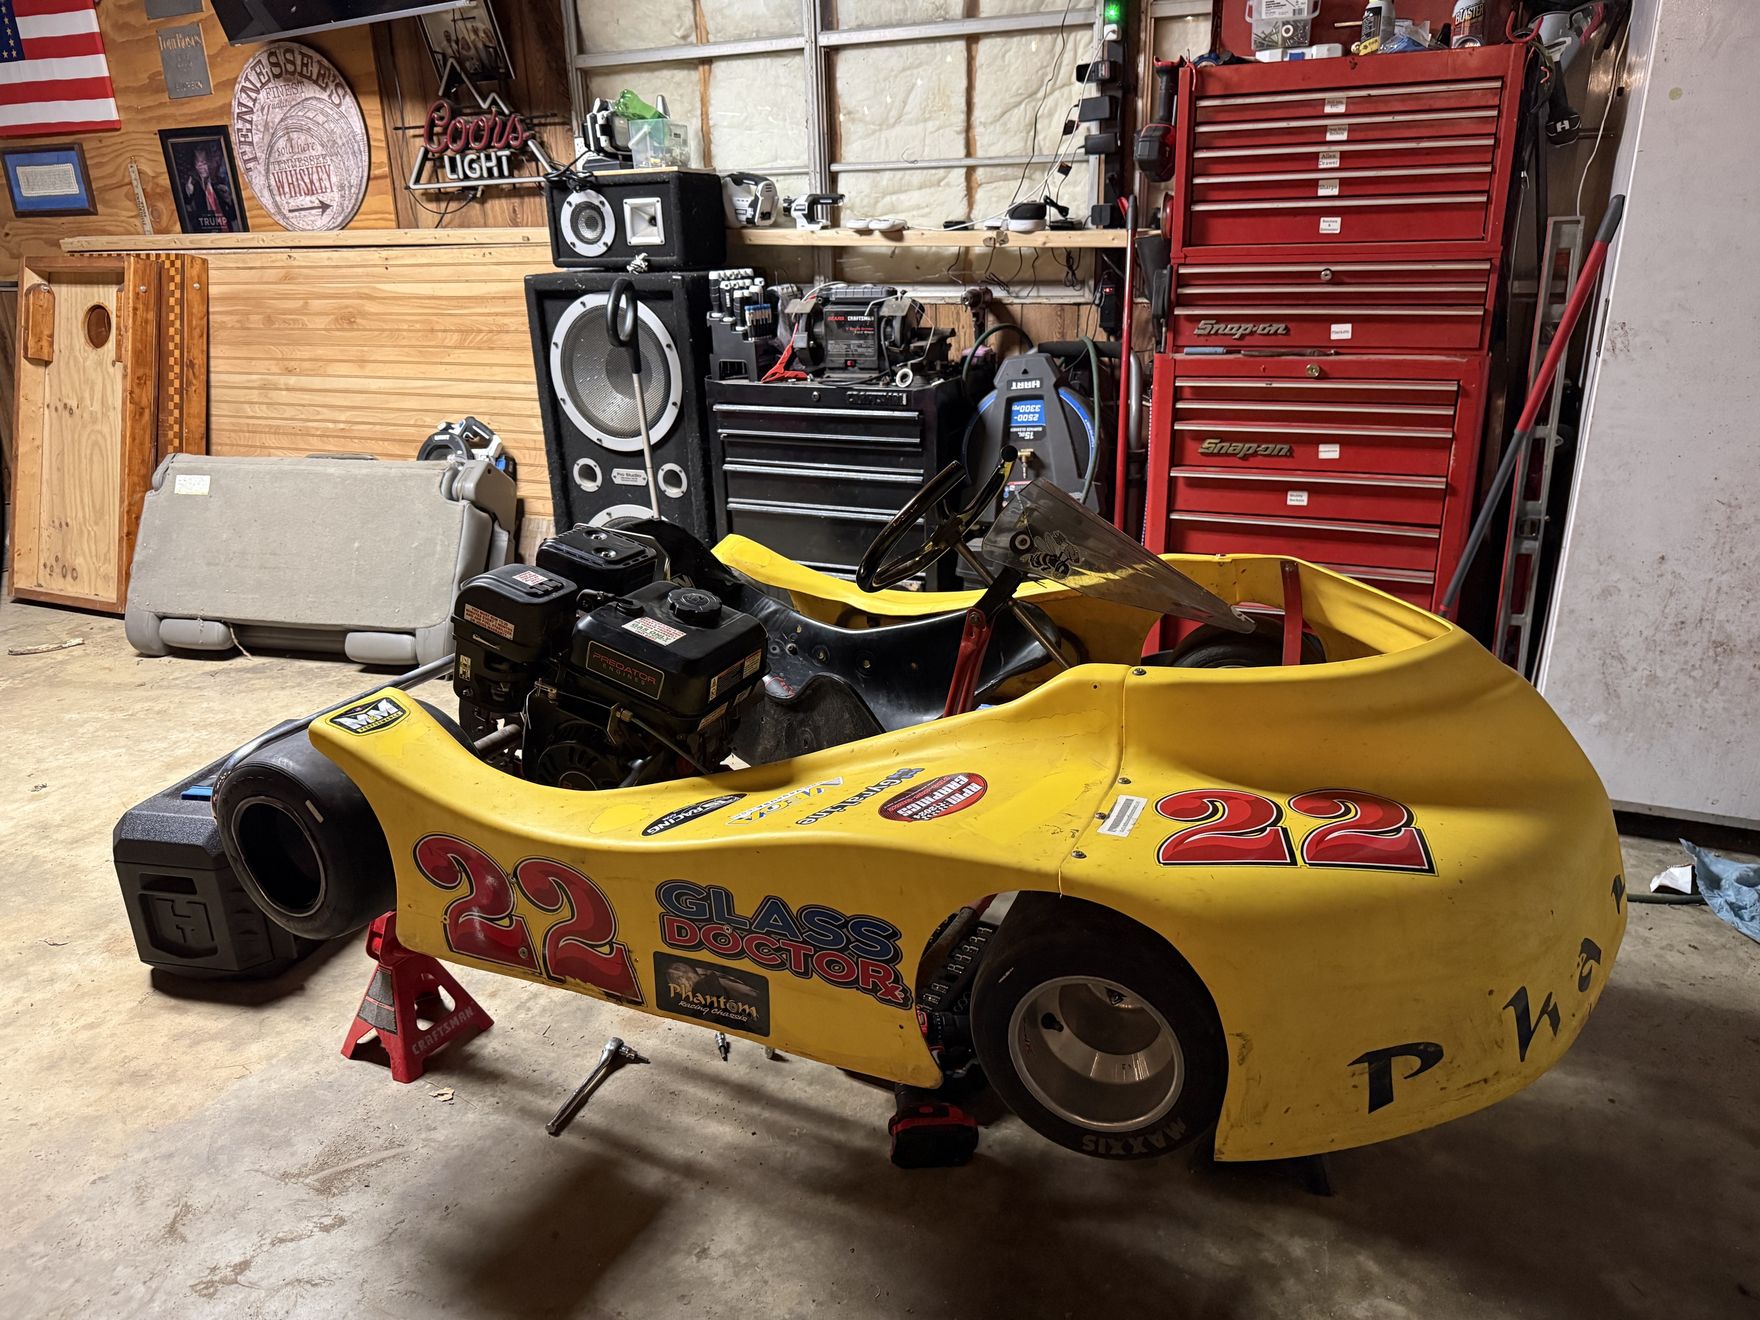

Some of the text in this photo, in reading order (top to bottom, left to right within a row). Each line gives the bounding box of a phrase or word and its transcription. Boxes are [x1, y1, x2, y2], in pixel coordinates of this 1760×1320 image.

[265, 82, 306, 100] FINEST
[236, 47, 349, 173] TENNESSEE'S
[424, 100, 526, 153] Coors
[269, 153, 330, 171] TENNESSEE
[444, 150, 511, 179] LIGHT
[272, 164, 335, 200] WHISKEY
[198, 217, 228, 226] TRUMP
[1010, 380, 1041, 390] HART
[592, 652, 657, 685] PREDATOR
[647, 806, 703, 835] RACING
[1152, 788, 1439, 876] 22
[413, 833, 648, 1007] 22
[655, 880, 903, 965] GLASS
[668, 982, 760, 1020] Phantom
[678, 1000, 749, 1022] Racing Chassis
[411, 1006, 475, 1055] CRAFTSMAN
[1082, 1117, 1187, 1154] MAXXIS
